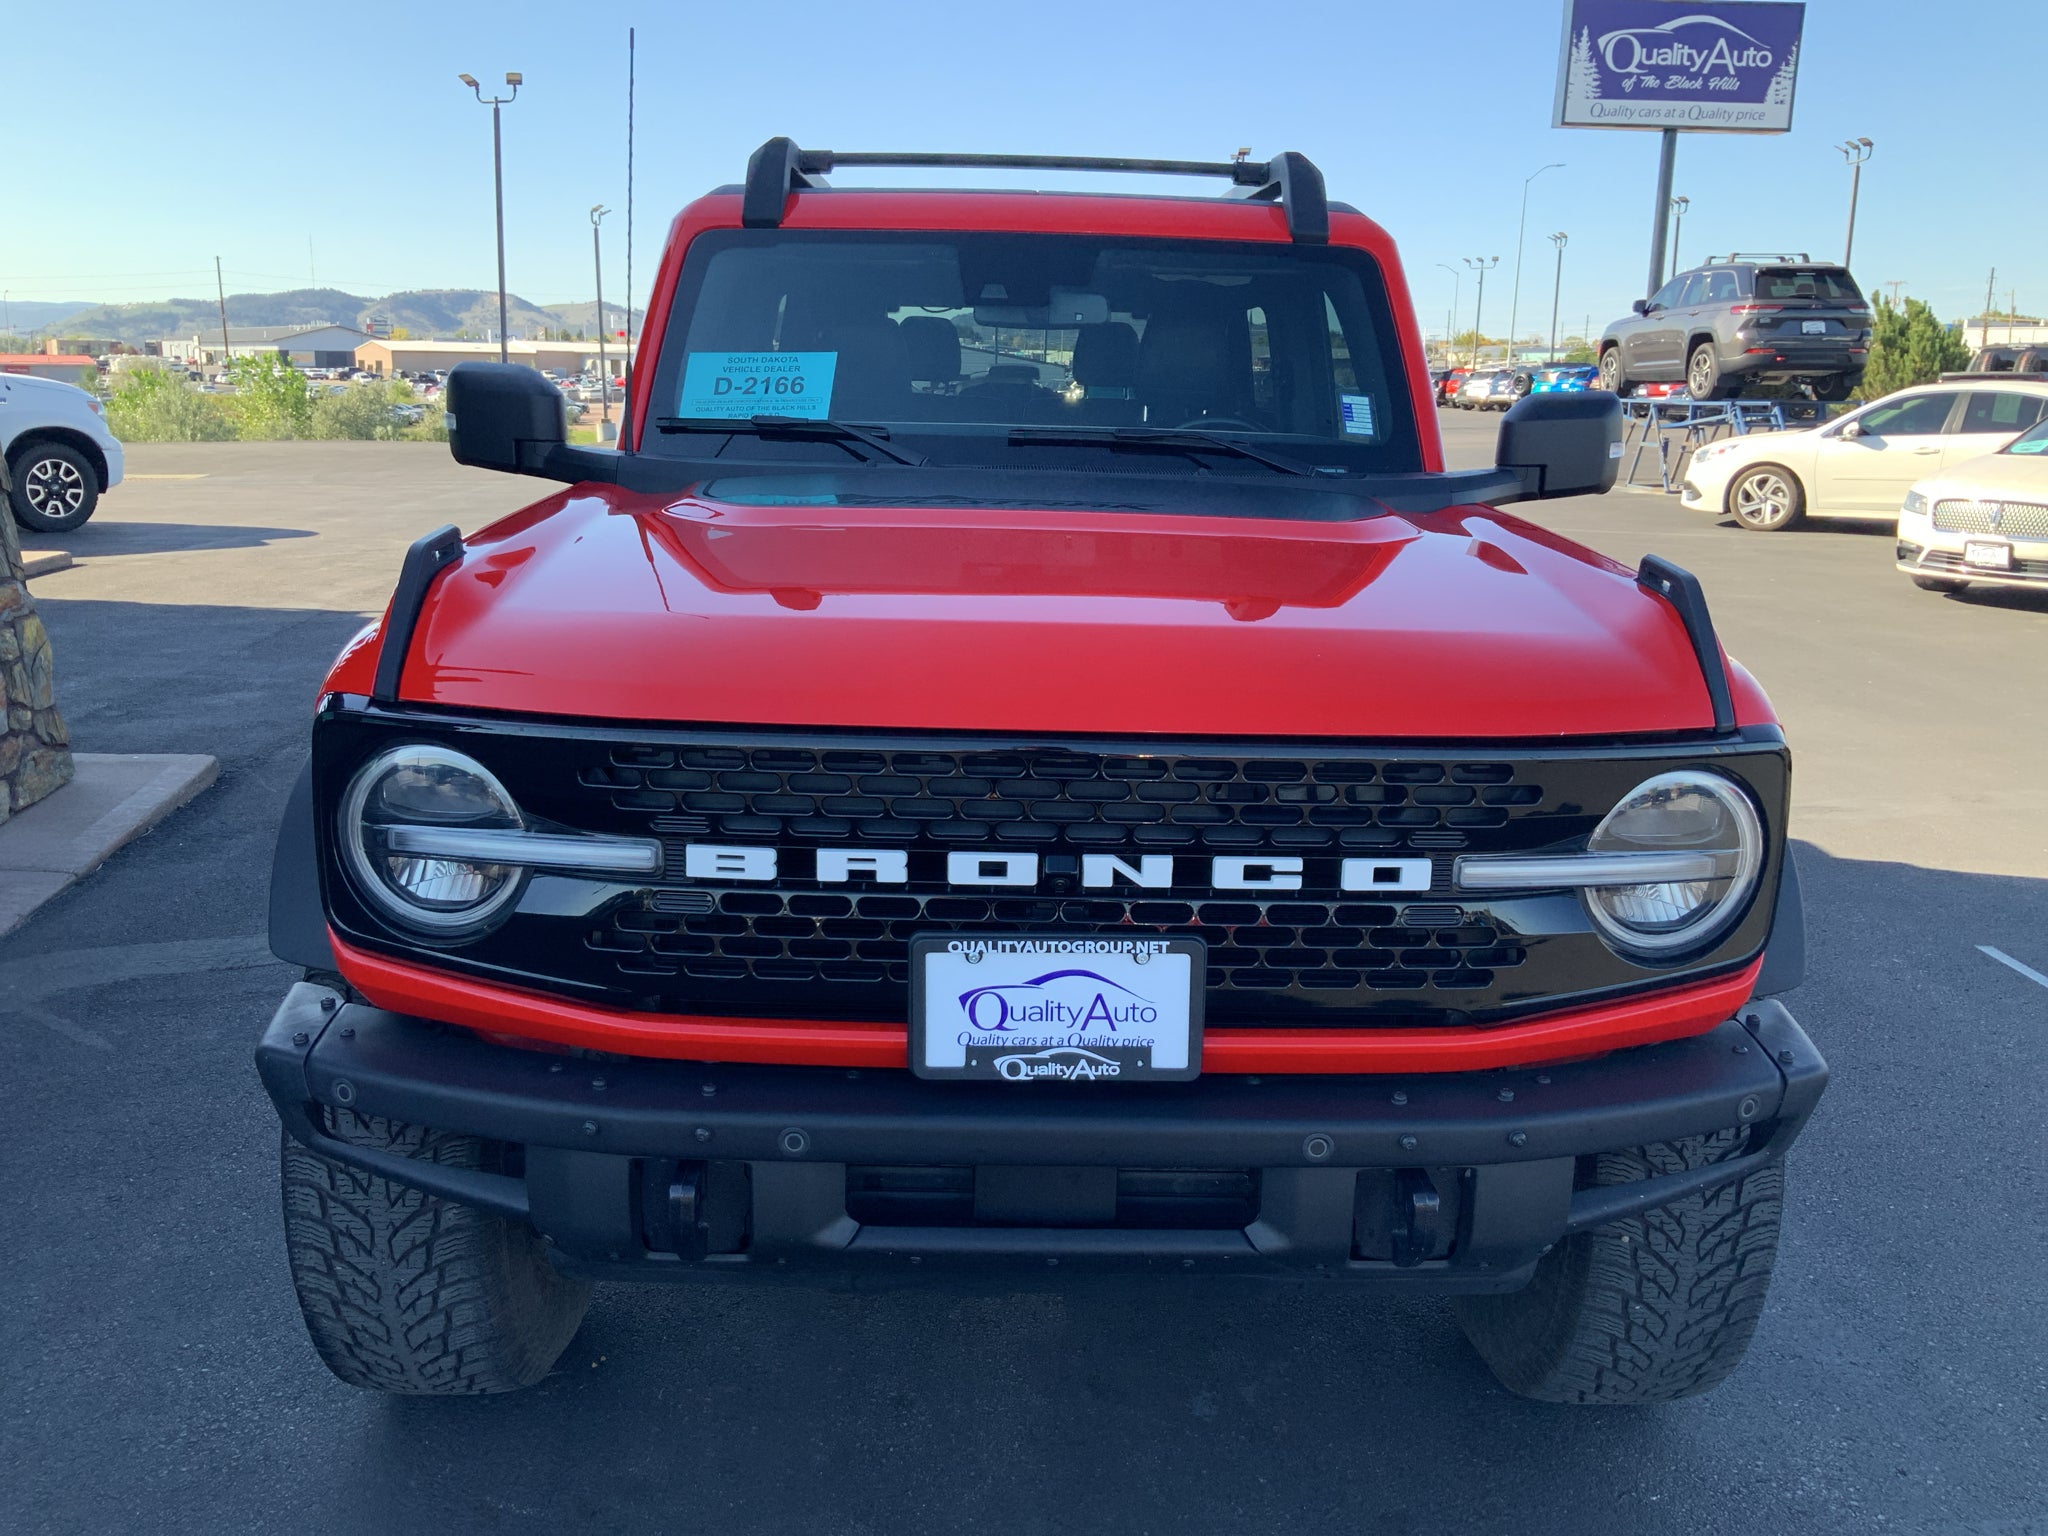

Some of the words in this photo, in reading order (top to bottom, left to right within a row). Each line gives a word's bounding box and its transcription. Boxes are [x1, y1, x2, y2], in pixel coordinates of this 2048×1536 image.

[1621, 75, 1637, 92] of
[1640, 75, 1661, 89] The
[1664, 75, 1702, 91] Black
[1708, 76, 1741, 91] Hills
[1590, 102, 1637, 120] Quality
[1638, 108, 1661, 119] cars
[1664, 108, 1677, 119] at
[1679, 110, 1686, 119] a
[1688, 104, 1734, 121] Quality
[1735, 109, 1766, 122] price
[728, 356, 760, 364] SOUTH
[713, 376, 805, 396] D-2166
[686, 843, 1432, 891] BRONCO
[948, 941, 1170, 954] QUALITYAUTOGROUP.NET
[957, 1031, 1009, 1047] Quality
[1012, 1036, 1037, 1046] cars
[1041, 1036, 1055, 1046] at
[1057, 1037, 1064, 1046] a
[1068, 1033, 1119, 1047] Quality
[1122, 1036, 1155, 1047] price
